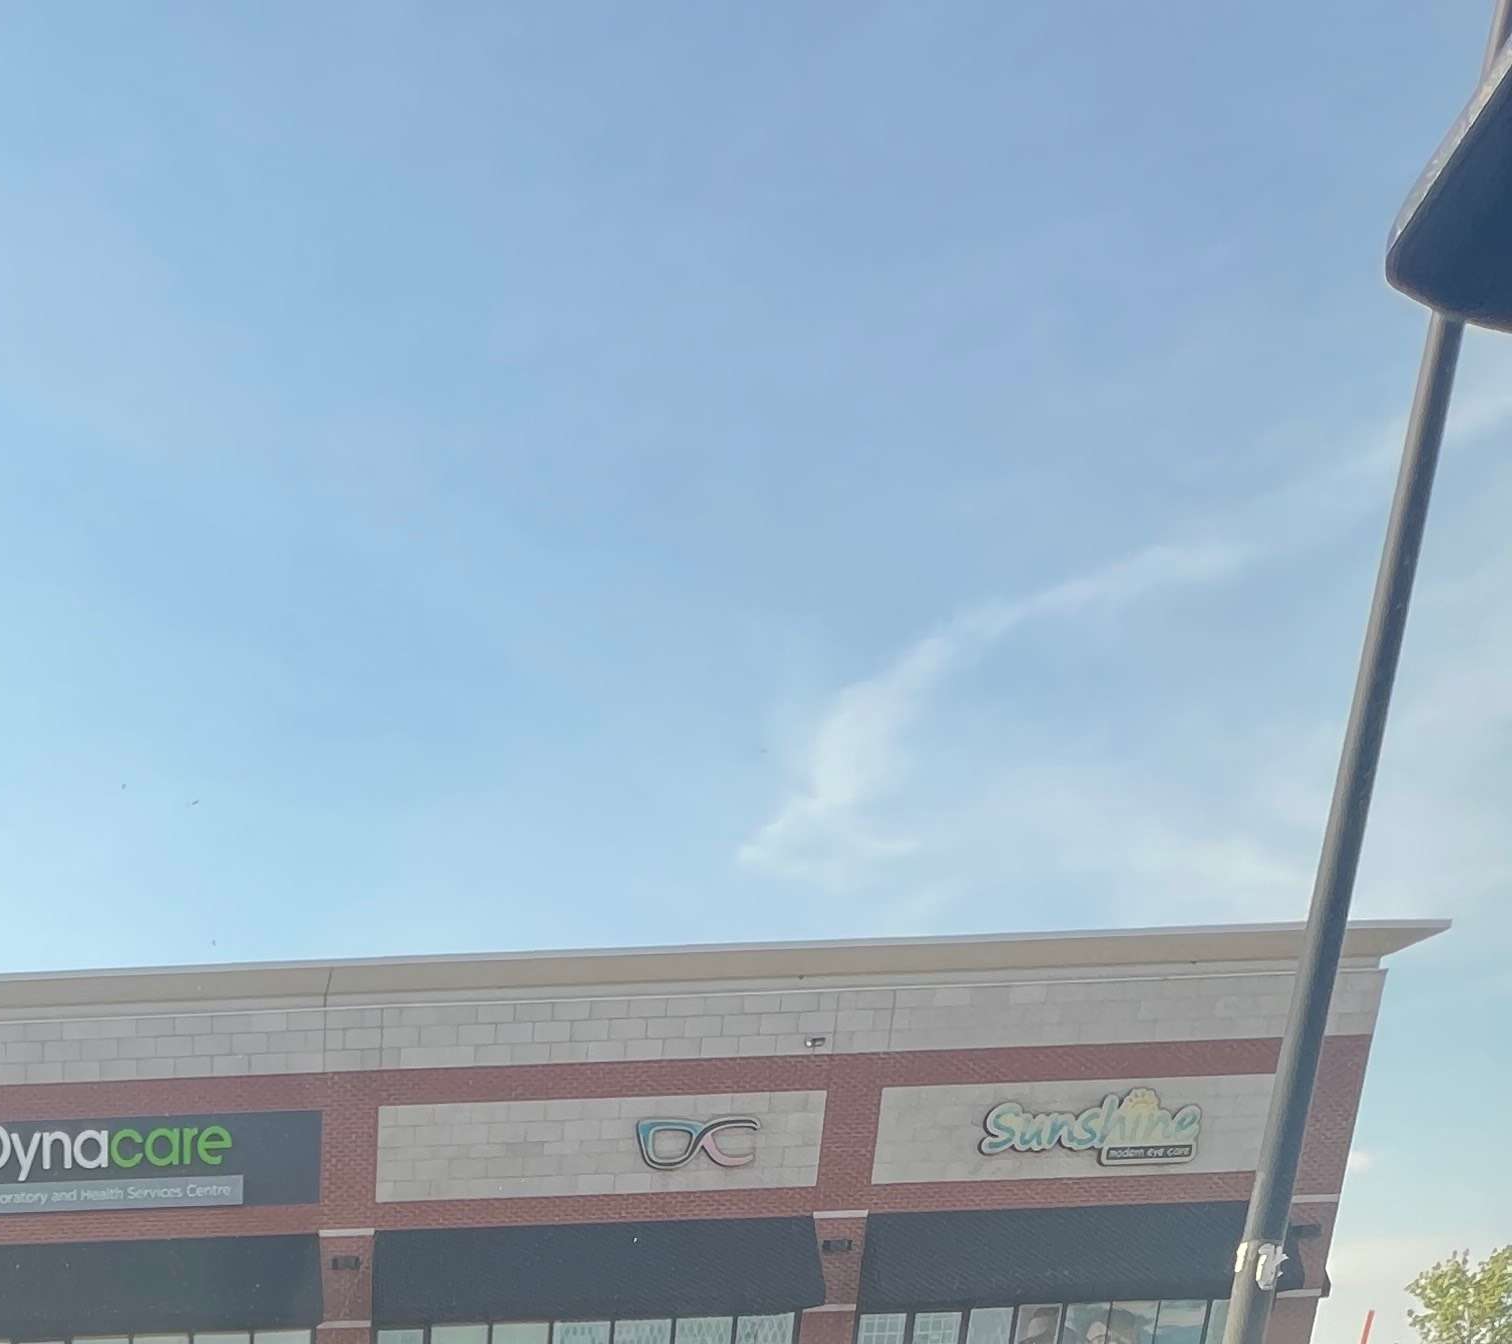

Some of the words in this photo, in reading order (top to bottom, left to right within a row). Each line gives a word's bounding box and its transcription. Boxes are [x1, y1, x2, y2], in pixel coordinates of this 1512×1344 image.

[982, 1094, 1199, 1152] Sunshine
[1109, 1148, 1144, 1159] modern
[1147, 1149, 1163, 1158] eye
[1167, 1148, 1189, 1157] care
[52, 1188, 78, 1201] and
[80, 1186, 123, 1201] Health
[126, 1185, 183, 1199] Services
[186, 1183, 232, 1197] Centre
